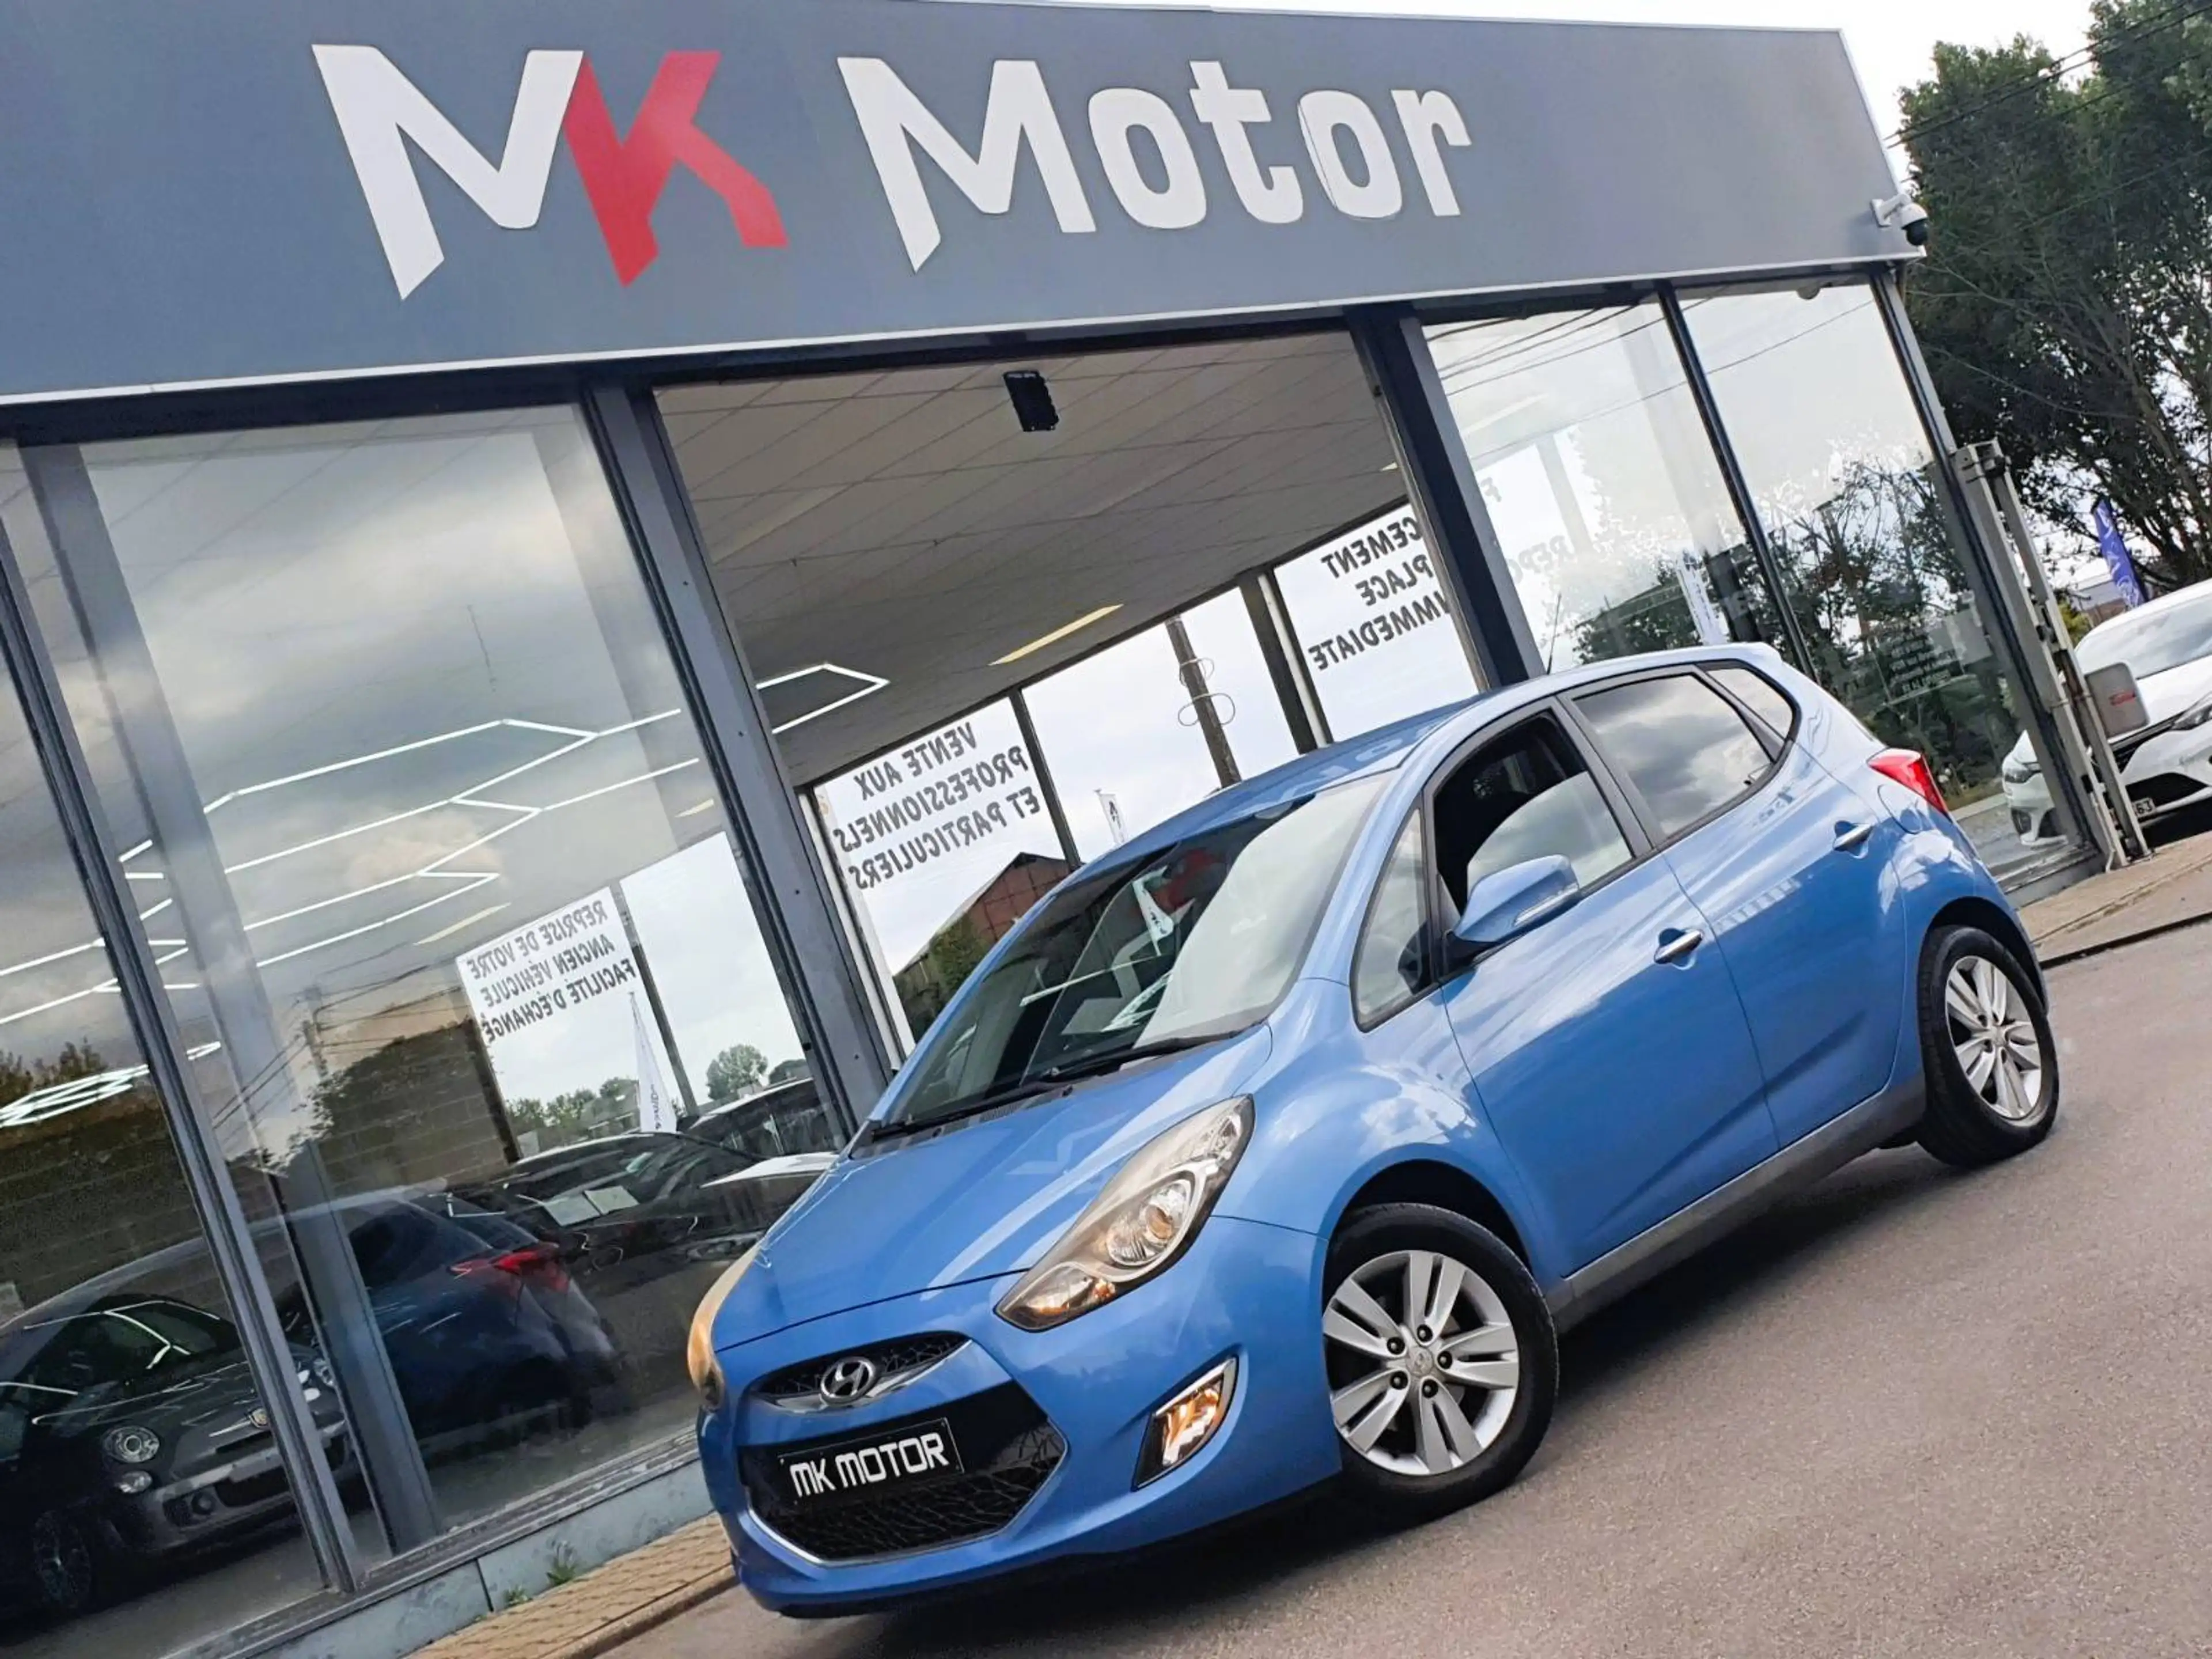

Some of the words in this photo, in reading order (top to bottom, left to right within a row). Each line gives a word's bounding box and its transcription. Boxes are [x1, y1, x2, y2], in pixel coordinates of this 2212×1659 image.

[313, 44, 787, 300] MK
[837, 57, 1471, 272] Motor
[790, 1458, 836, 1497] MK
[835, 1433, 949, 1488] MOTOR
